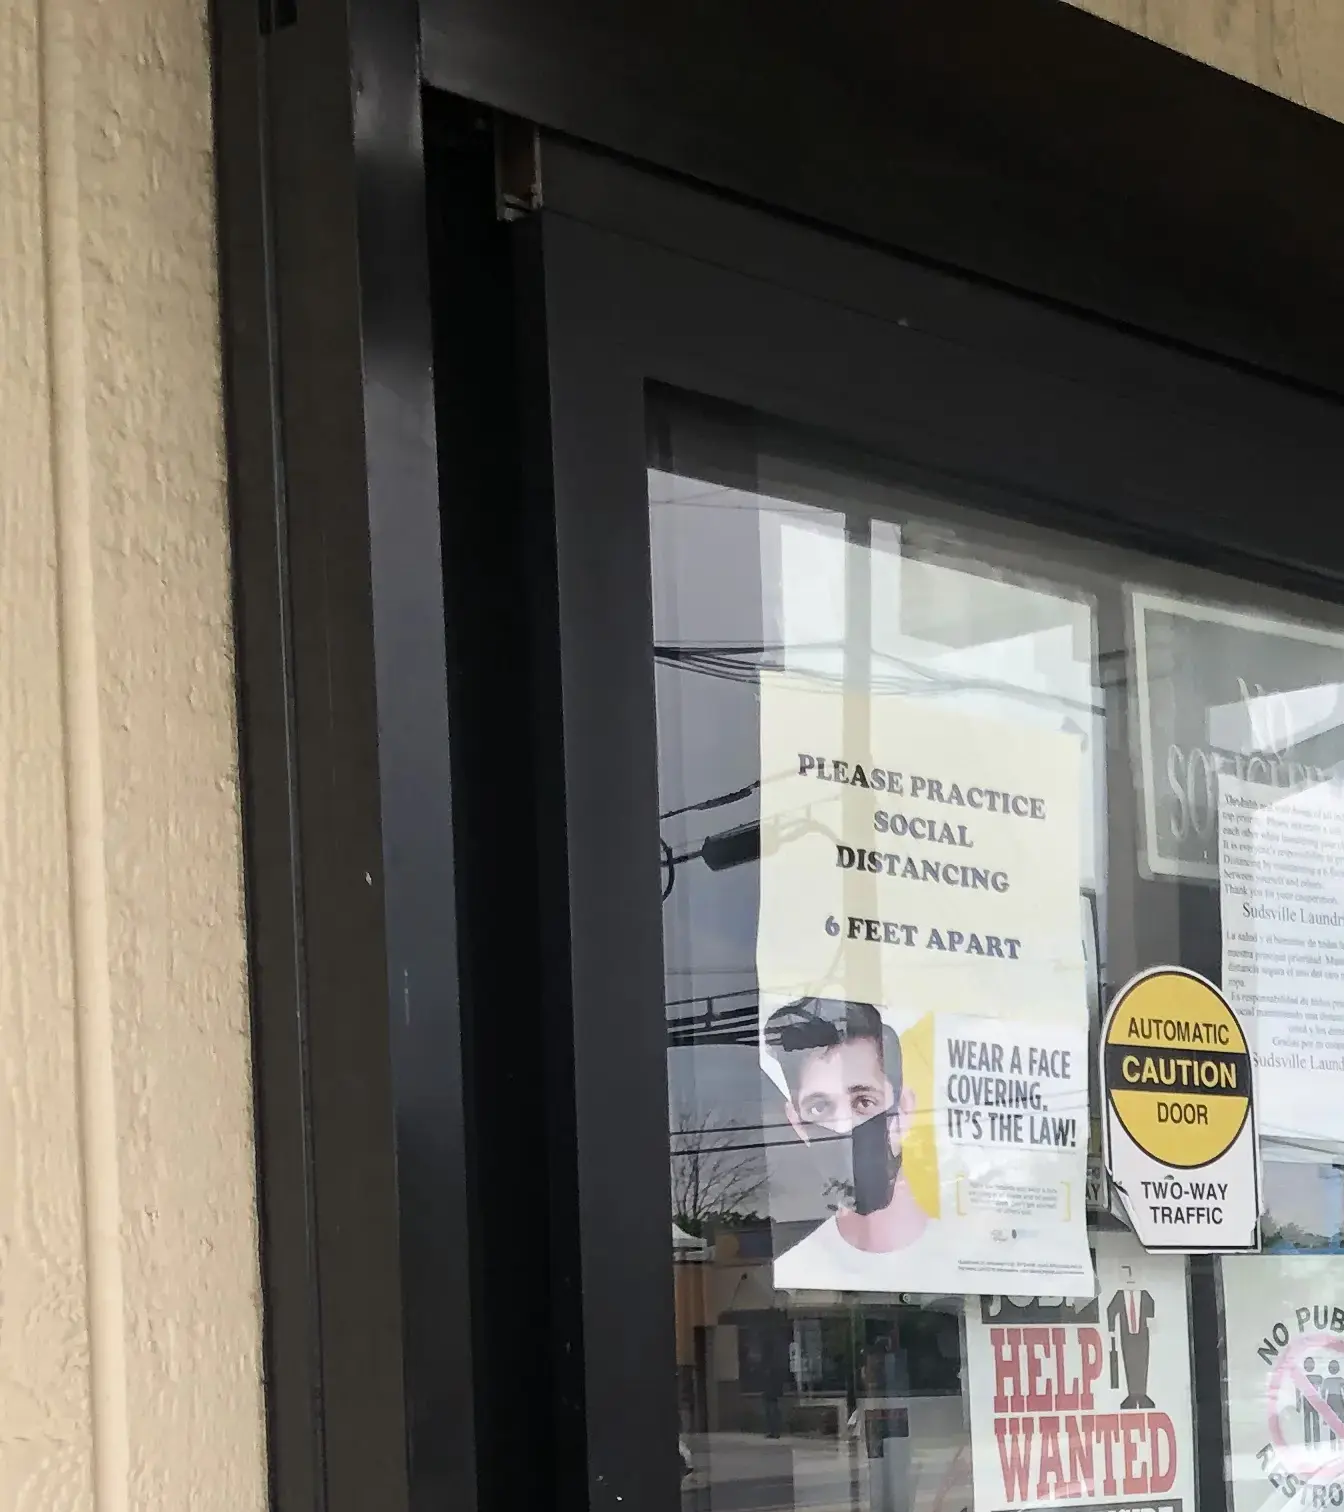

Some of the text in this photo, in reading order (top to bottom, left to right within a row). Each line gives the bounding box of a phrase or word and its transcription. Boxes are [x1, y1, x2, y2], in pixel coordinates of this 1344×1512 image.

[797, 753, 1047, 820] PLEASE PRACTICE
[873, 809, 974, 849] SOCIAL
[835, 844, 1010, 894] DISTANCING
[1242, 903, 1297, 923] Sudsville
[824, 915, 1022, 960] 6 FEET APART
[1128, 1016, 1230, 1046] AUTOMATIC
[947, 1038, 1072, 1079] WEAR A FACE
[1121, 1055, 1237, 1090] CAUTION
[1253, 1052, 1307, 1071] Sudsville
[947, 1074, 1048, 1112] COVERING.
[947, 1108, 1076, 1148] IT'S THE LAW!
[1156, 1101, 1209, 1126] DOOR
[1141, 1181, 1229, 1201] TWO-WAY
[1149, 1206, 1224, 1225] TRAFFIC
[1257, 1322, 1290, 1366] NO
[990, 1327, 1103, 1413] HELP
[994, 1412, 1177, 1503] WANTED
